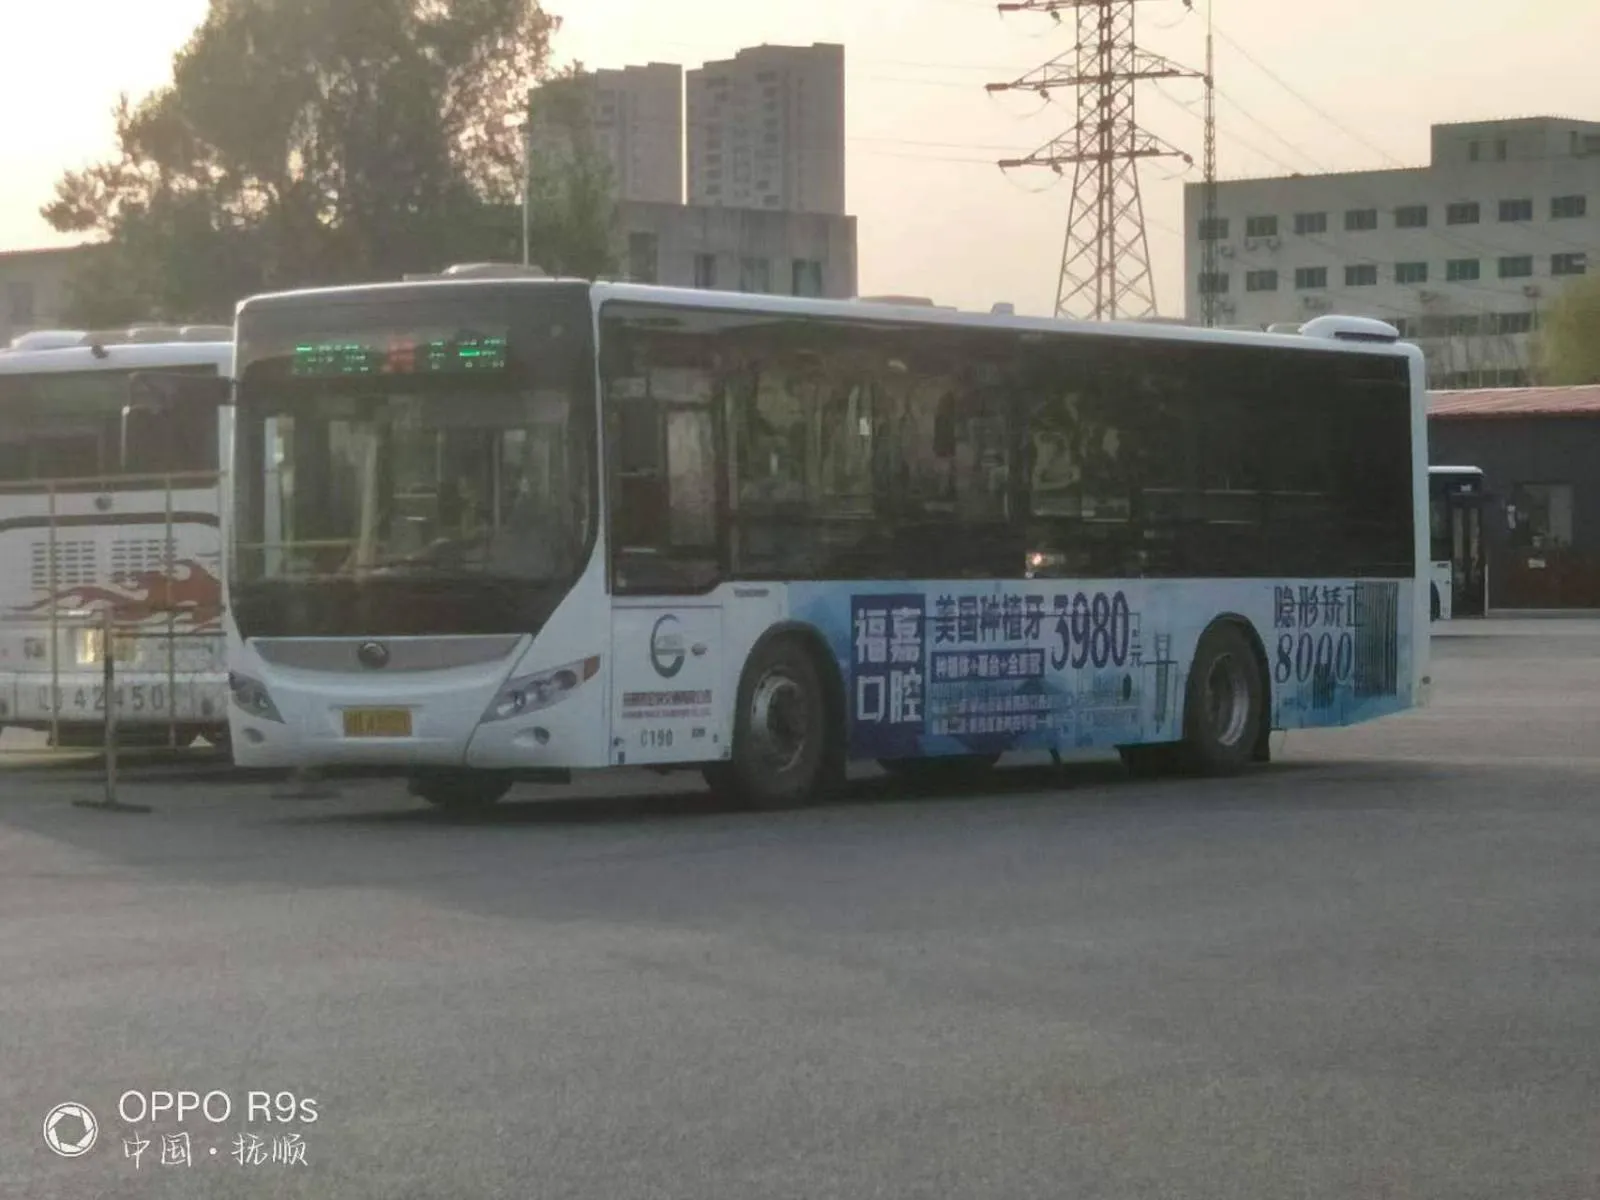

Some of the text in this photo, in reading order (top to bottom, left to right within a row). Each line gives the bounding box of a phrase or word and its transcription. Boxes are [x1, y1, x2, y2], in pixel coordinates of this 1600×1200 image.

[935, 595, 1045, 643] 美国种植牙
[1051, 590, 1129, 671] 3980
[1274, 585, 1363, 628] 隐形矫正
[1275, 632, 1352, 684] 8000
[857, 668, 922, 724] 口腔
